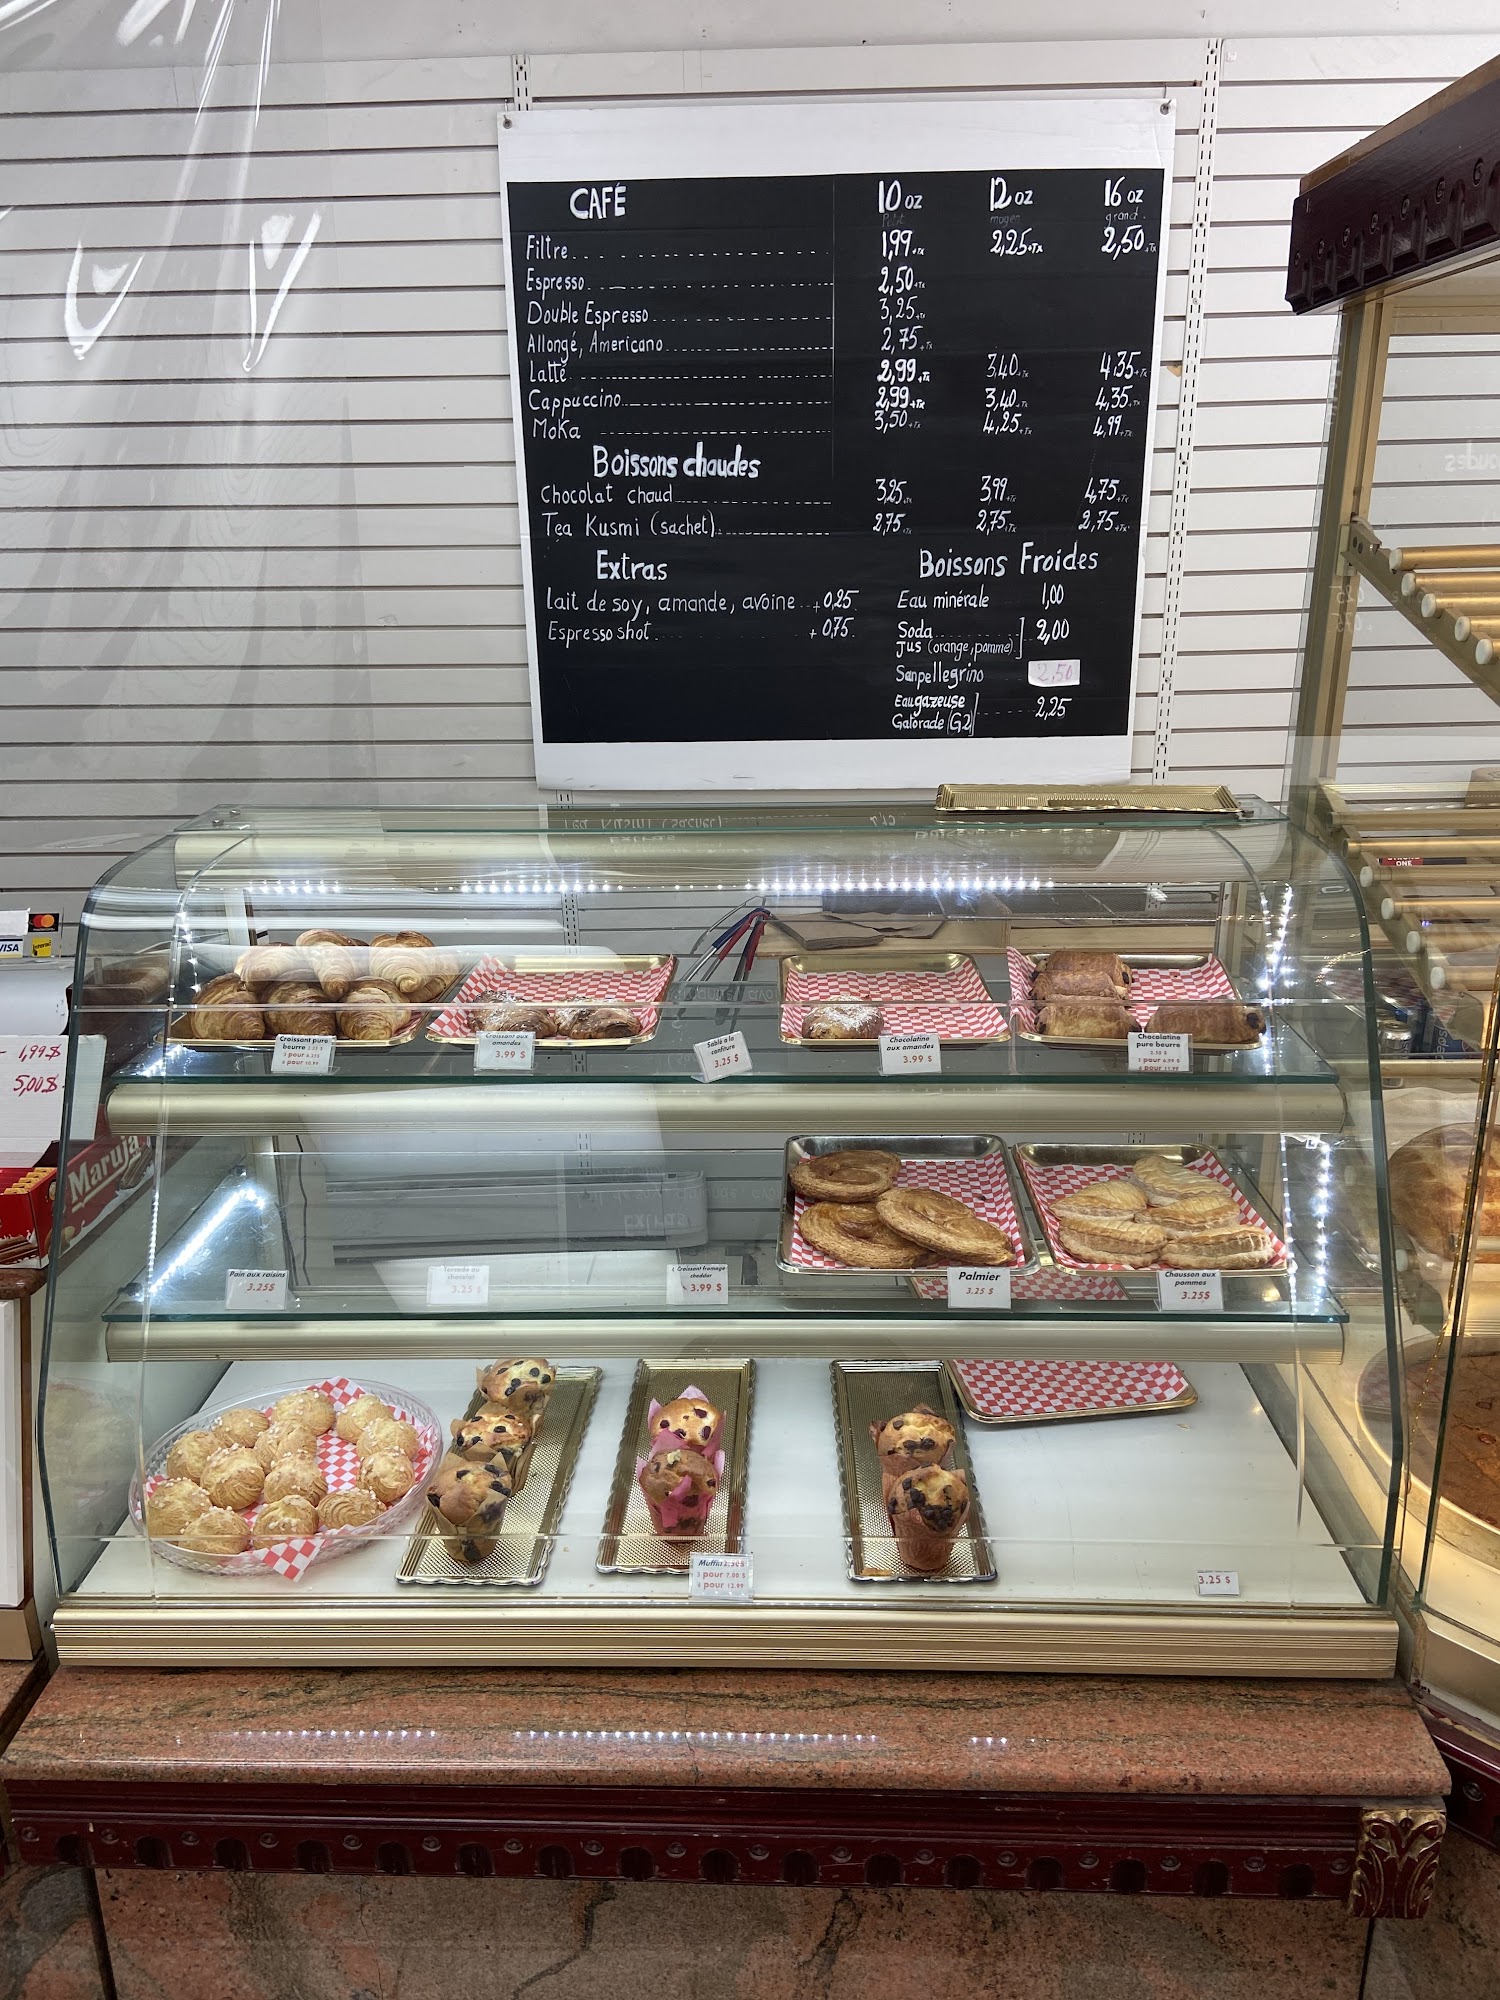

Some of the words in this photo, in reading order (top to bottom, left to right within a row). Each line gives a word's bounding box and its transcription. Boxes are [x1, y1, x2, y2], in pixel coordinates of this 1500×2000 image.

[570, 182, 626, 219] CAFÉ
[878, 180, 902, 213] 10
[904, 194, 923, 210] oz
[990, 176, 1012, 212] 12
[1014, 190, 1034, 206] oz
[1104, 176, 1126, 206] 16
[1127, 190, 1144, 204] oz
[526, 234, 568, 260] Filtre
[882, 230, 913, 261] 1,99
[990, 228, 1033, 256] 2,25
[1102, 224, 1145, 260] 2,50
[526, 268, 585, 300] Espresso
[878, 266, 914, 296] 2,50
[527, 301, 579, 324] Double
[584, 301, 648, 331] Espresso
[880, 296, 918, 325] 3,25
[589, 331, 664, 352] Americano
[881, 326, 924, 354] 2,75
[877, 358, 917, 384] 2,99
[986, 353, 1020, 380] 3,40
[1100, 351, 1142, 380] 4,35
[528, 388, 622, 419] Cappuccino
[876, 386, 910, 410] 2,99
[984, 387, 1018, 410] 3,40
[1095, 385, 1134, 410] 4,35
[874, 410, 908, 434] 3,50
[982, 411, 1023, 434] 4,25
[1093, 414, 1122, 438] 4,99
[592, 445, 678, 478] Boissons
[682, 442, 762, 478] chaudes
[541, 482, 613, 504] Chocolat
[628, 484, 673, 504] chaud
[875, 478, 908, 505] 3,25
[980, 475, 1009, 505] 3,99
[1084, 477, 1120, 504] 4,75
[542, 512, 573, 537] Tea
[585, 512, 640, 536] Kusmi
[650, 510, 715, 538] (sachet)
[872, 512, 906, 536] 2,75
[976, 508, 1012, 535] 2,75
[1078, 508, 1118, 531] 2,75
[596, 550, 668, 580] Extras
[920, 548, 1008, 578] Boissons
[1020, 540, 1098, 574] Froides
[586, 590, 607, 612] de
[612, 596, 650, 621] soy,
[658, 590, 735, 614] amande,
[742, 594, 796, 611] avoine
[897, 590, 928, 609] Eau
[933, 584, 990, 608] minérale
[1042, 582, 1064, 608] 1,00
[549, 621, 613, 648] Espresso
[617, 620, 652, 641] shot
[898, 619, 933, 639] Soda
[1036, 618, 1070, 645] 2,00
[896, 640, 922, 658] Jus
[896, 661, 984, 690] Sanpellegrino
[892, 712, 944, 730] Gatorade
[1035, 696, 1072, 720] 2,25
[711, 1044, 735, 1055] confiture
[890, 1035, 930, 1043] Chocolatine
[495, 1050, 516, 1058] 3.99
[520, 1050, 526, 1059] $
[714, 1056, 731, 1068] 3.25
[734, 1053, 739, 1062] $
[903, 1055, 924, 1064] 3.99
[68, 1136, 139, 1205] Maruja
[690, 1283, 712, 1292] 3.99
[716, 1283, 722, 1292] $
[959, 1271, 1001, 1281] Palmier
[451, 1285, 473, 1294] 3.25
[966, 1287, 985, 1295] 3.25
[988, 1287, 994, 1295] $
[704, 1582, 724, 1590] pour
[1198, 1575, 1221, 1584] 3.25
[1225, 1576, 1231, 1584] $
